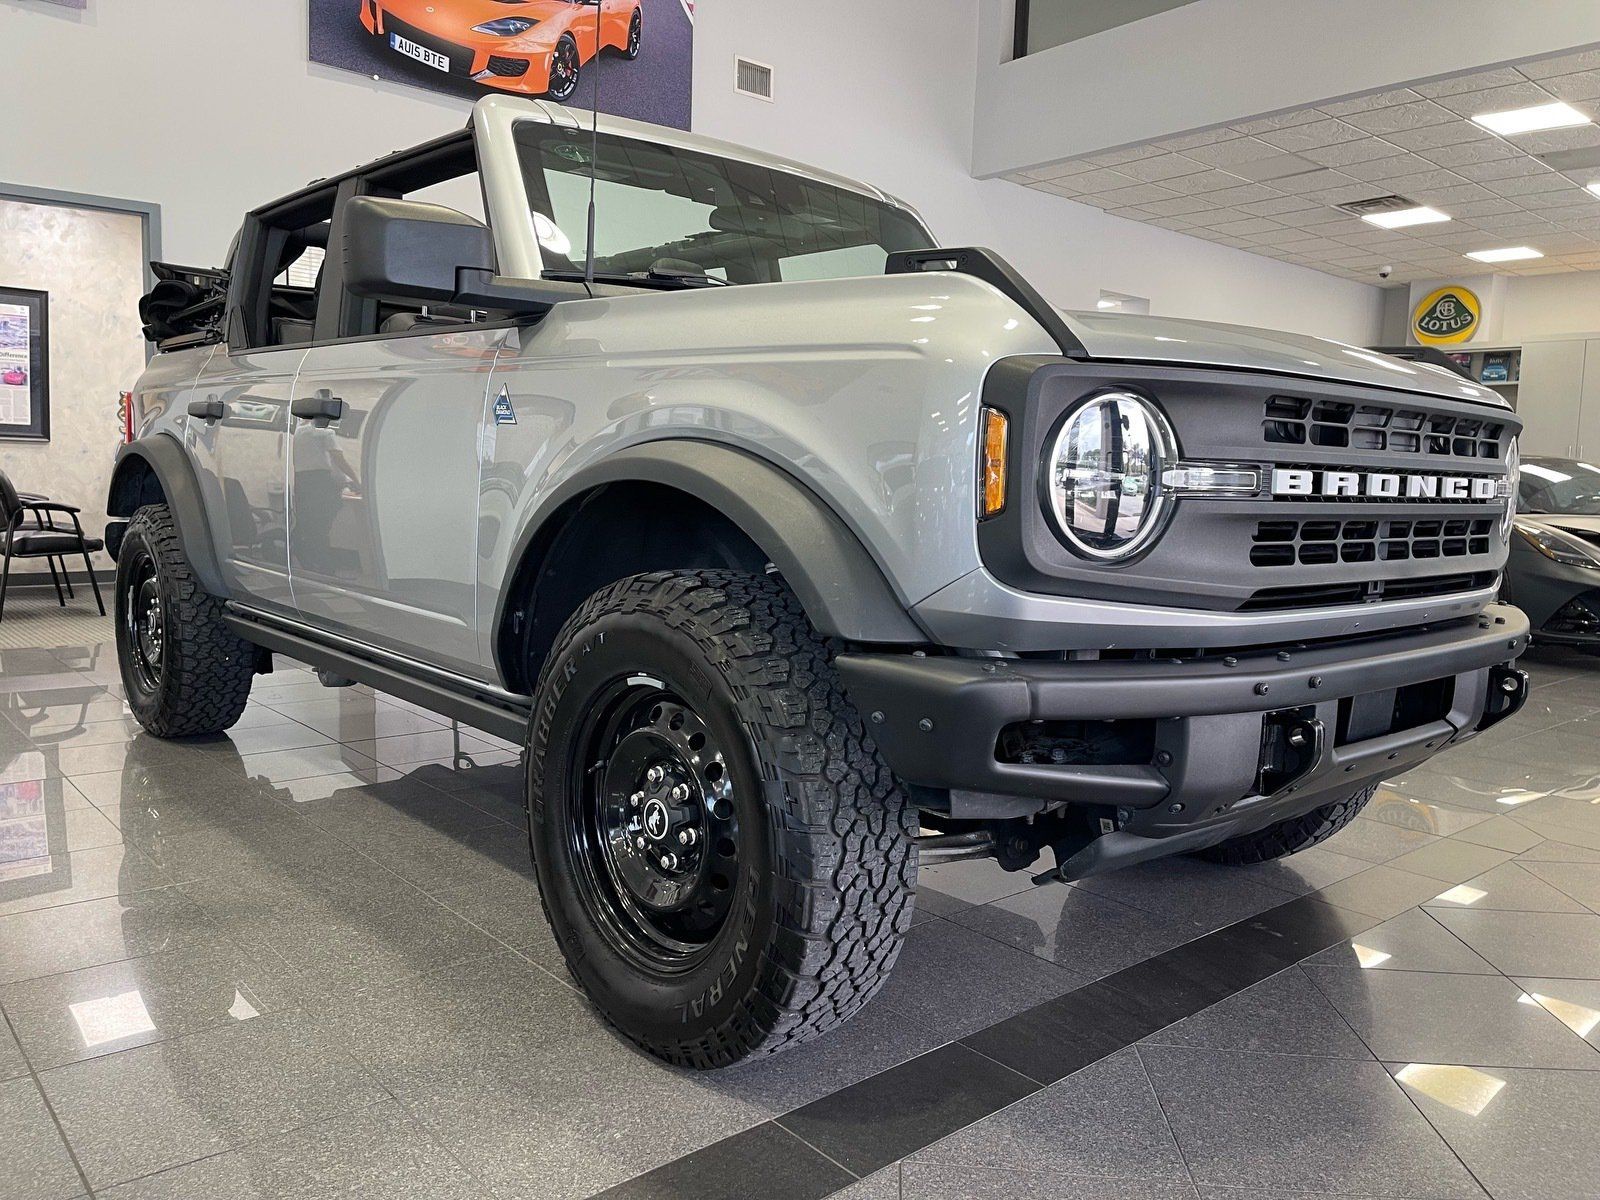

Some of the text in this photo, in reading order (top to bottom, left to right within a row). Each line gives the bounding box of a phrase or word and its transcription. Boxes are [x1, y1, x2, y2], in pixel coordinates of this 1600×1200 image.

[424, 50, 445, 68] BTE
[1420, 313, 1472, 332] LOTUS
[1272, 468, 1495, 499] BRONCO
[674, 864, 761, 1024] GENERAL
